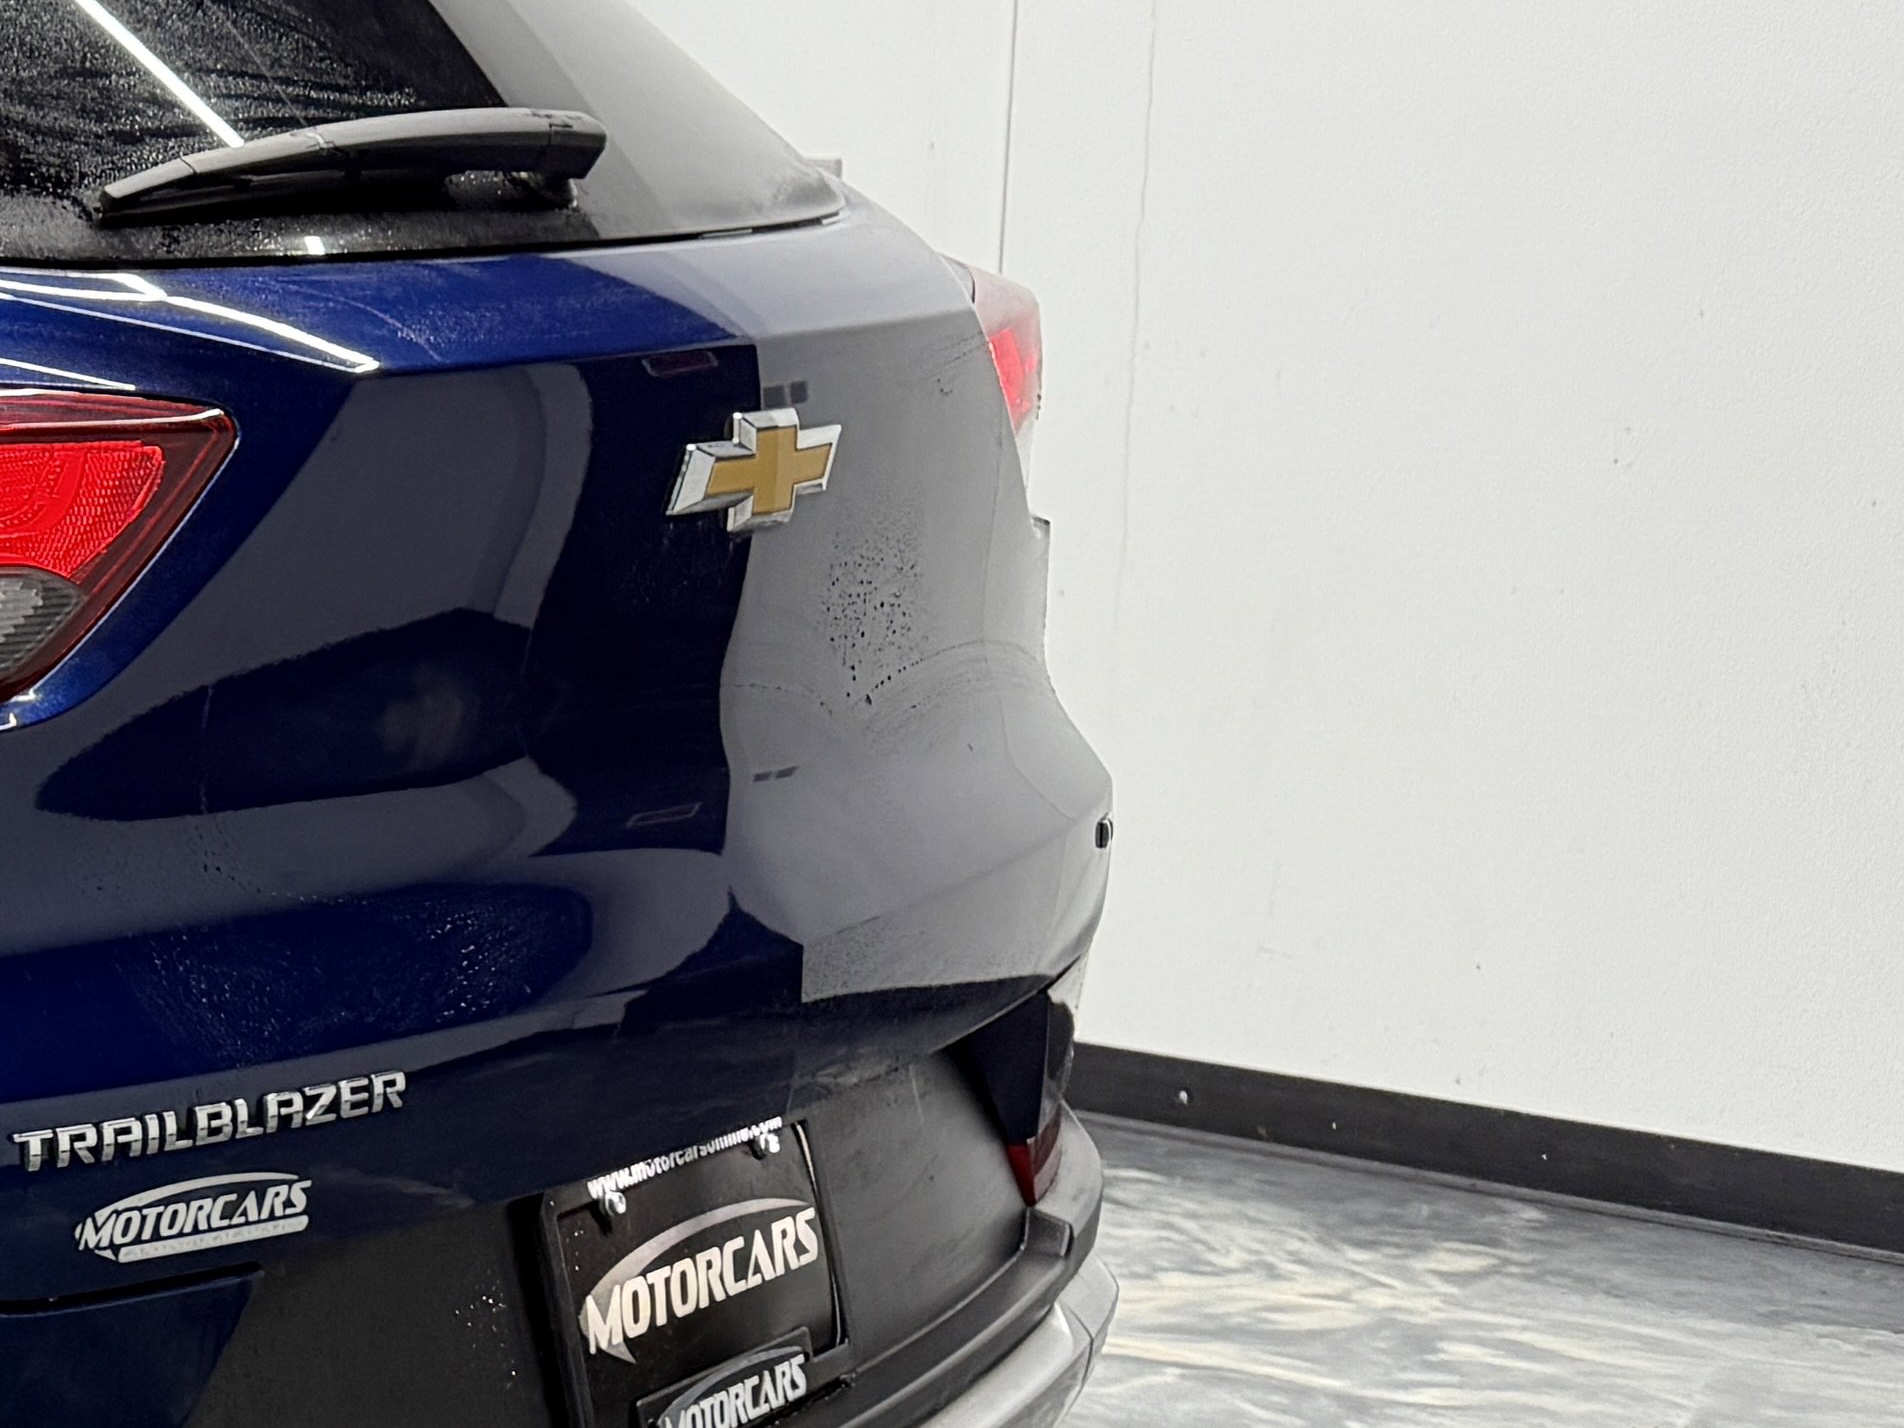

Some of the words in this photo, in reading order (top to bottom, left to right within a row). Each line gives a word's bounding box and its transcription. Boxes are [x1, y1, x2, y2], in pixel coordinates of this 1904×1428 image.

[11, 1071, 406, 1171] TRAILBLAZER
[76, 1179, 313, 1251] MOTORCARS
[585, 1206, 819, 1355] MOTORCARS
